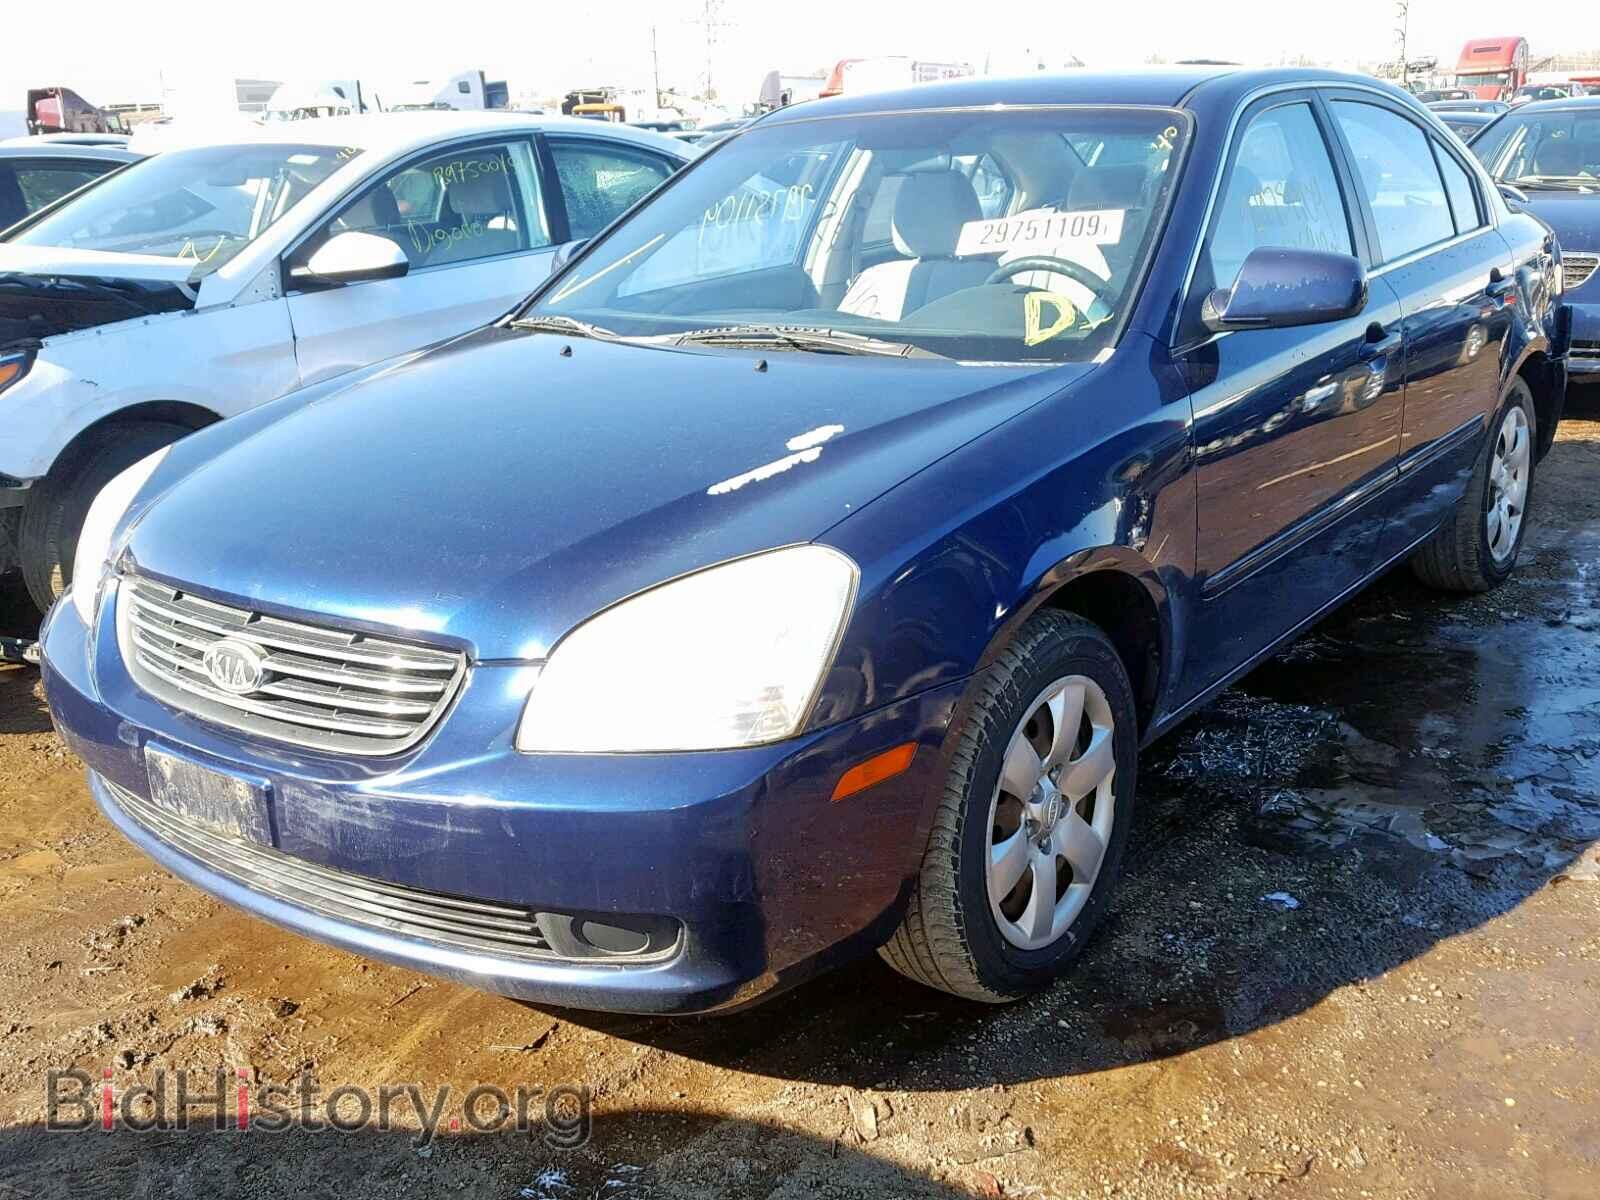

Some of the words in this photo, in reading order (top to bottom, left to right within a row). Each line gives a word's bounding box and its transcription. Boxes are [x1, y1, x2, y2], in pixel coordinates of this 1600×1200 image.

[978, 214, 1101, 246] 29751109
[1023, 291, 1077, 347] D
[210, 654, 249, 688] KIA
